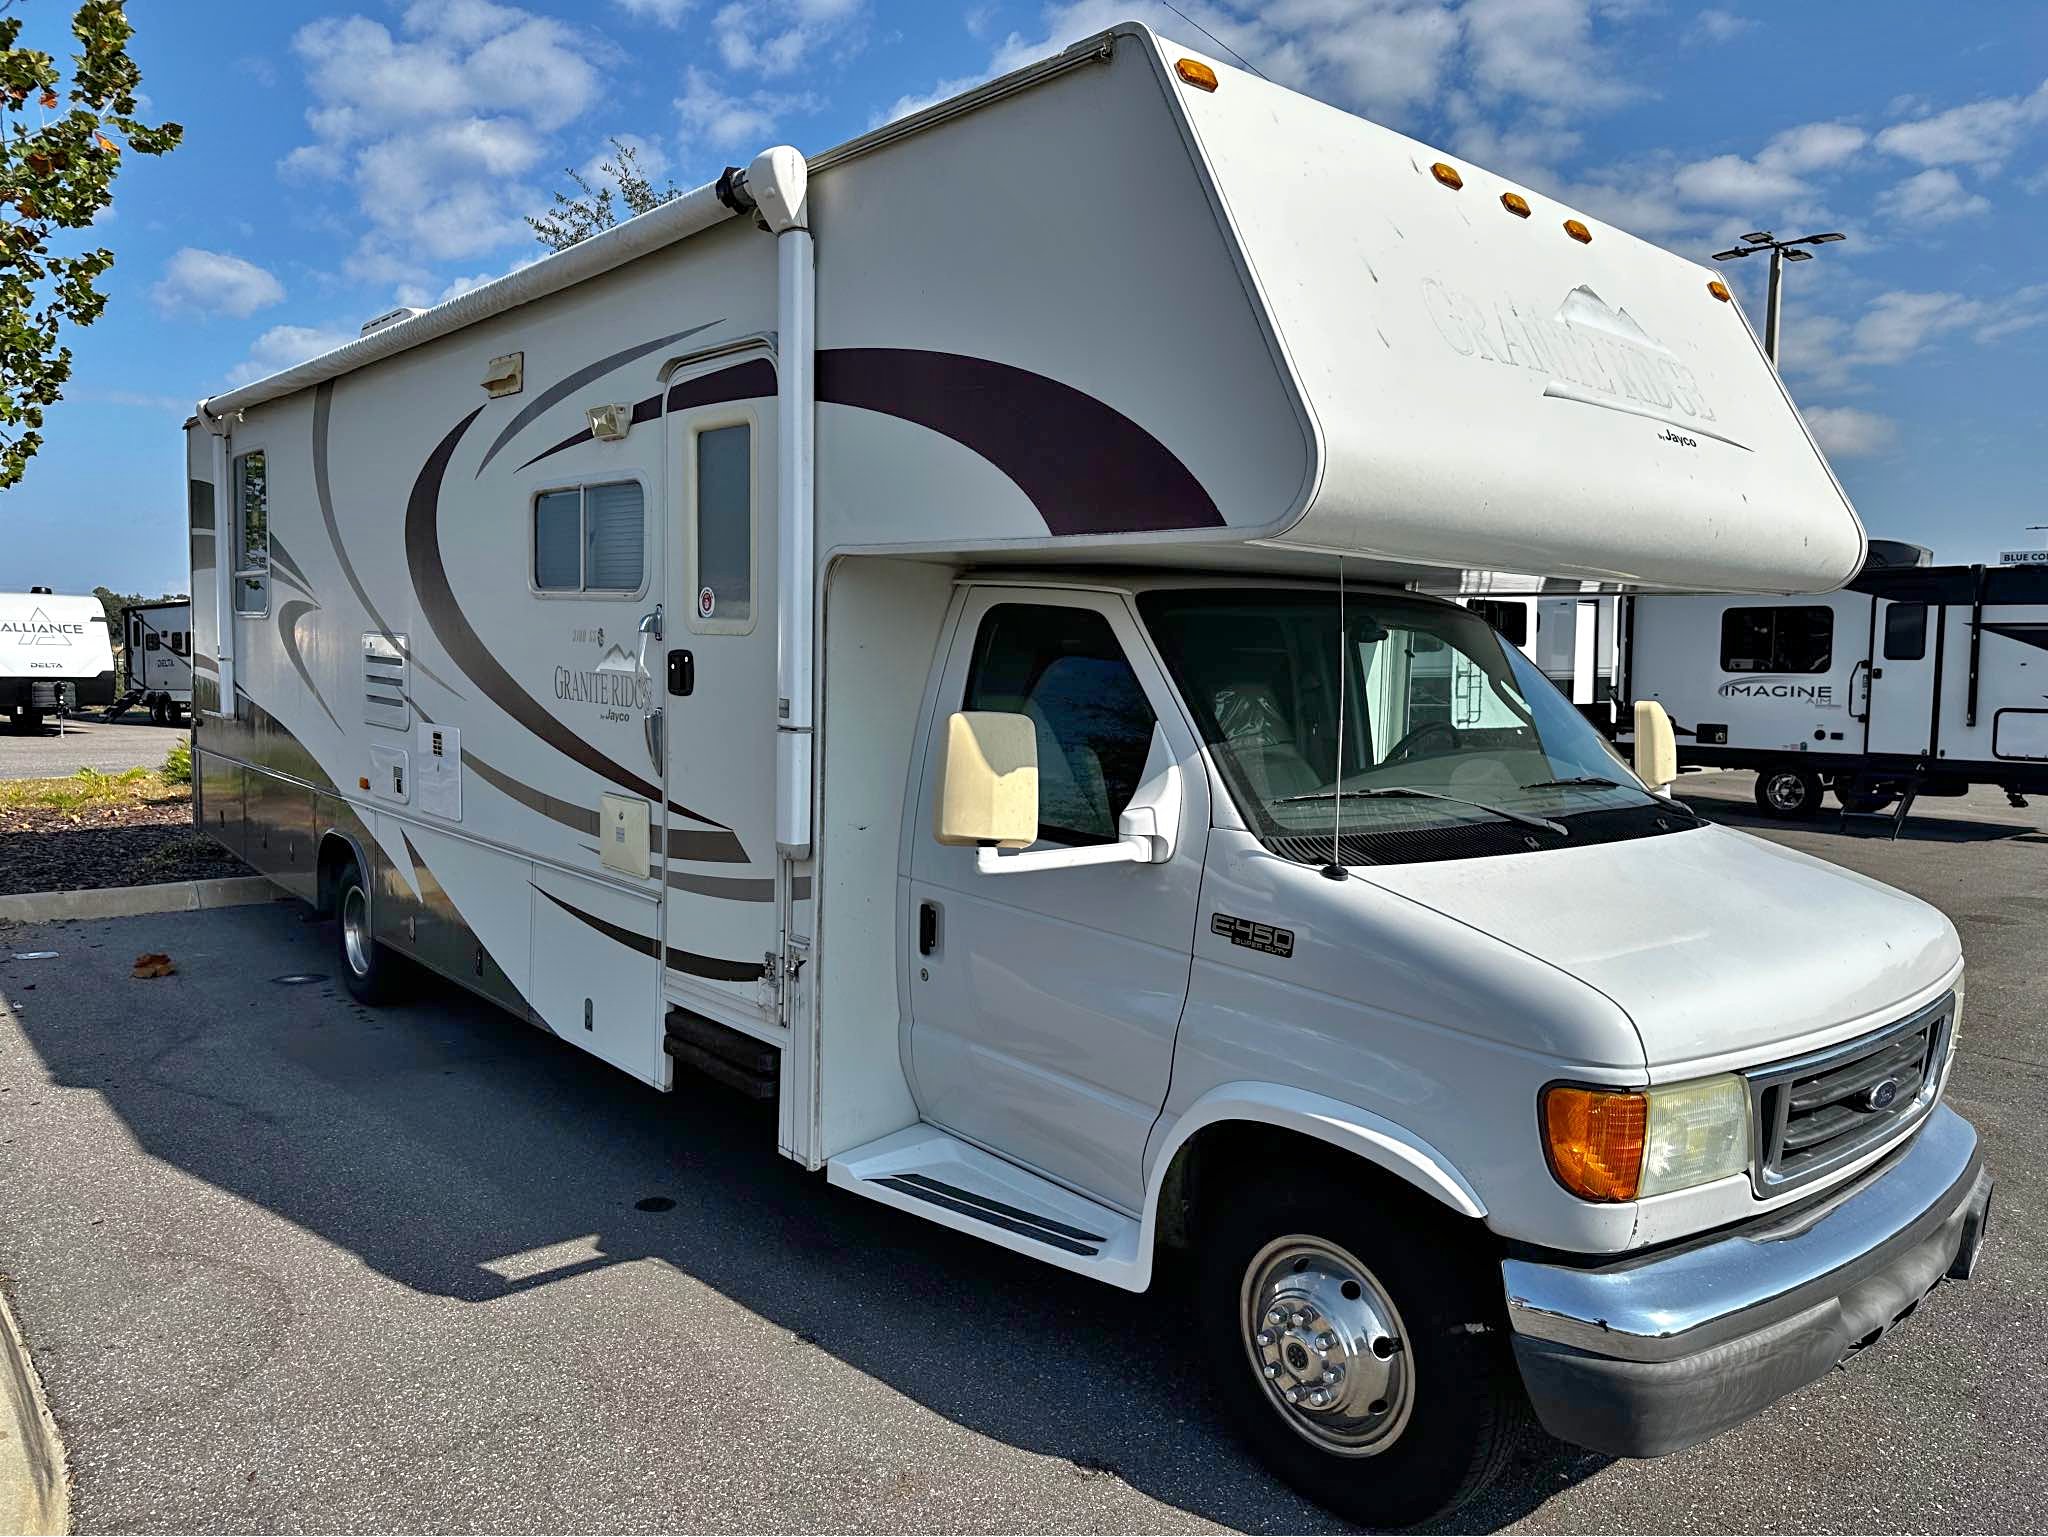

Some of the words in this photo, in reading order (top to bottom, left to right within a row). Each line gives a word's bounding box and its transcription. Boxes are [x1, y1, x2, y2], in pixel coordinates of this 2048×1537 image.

[1665, 428, 1697, 448] Jayco
[2004, 553, 2029, 561] BLUE
[0, 622, 84, 634] ALLIANCE
[554, 665, 608, 705] GRANITE
[1724, 685, 1832, 698] IMAGINE
[605, 708, 630, 723] Jayco
[1212, 914, 1293, 950] E-450
[1234, 937, 1263, 950] SUPER
[1264, 944, 1289, 956] DUTY
